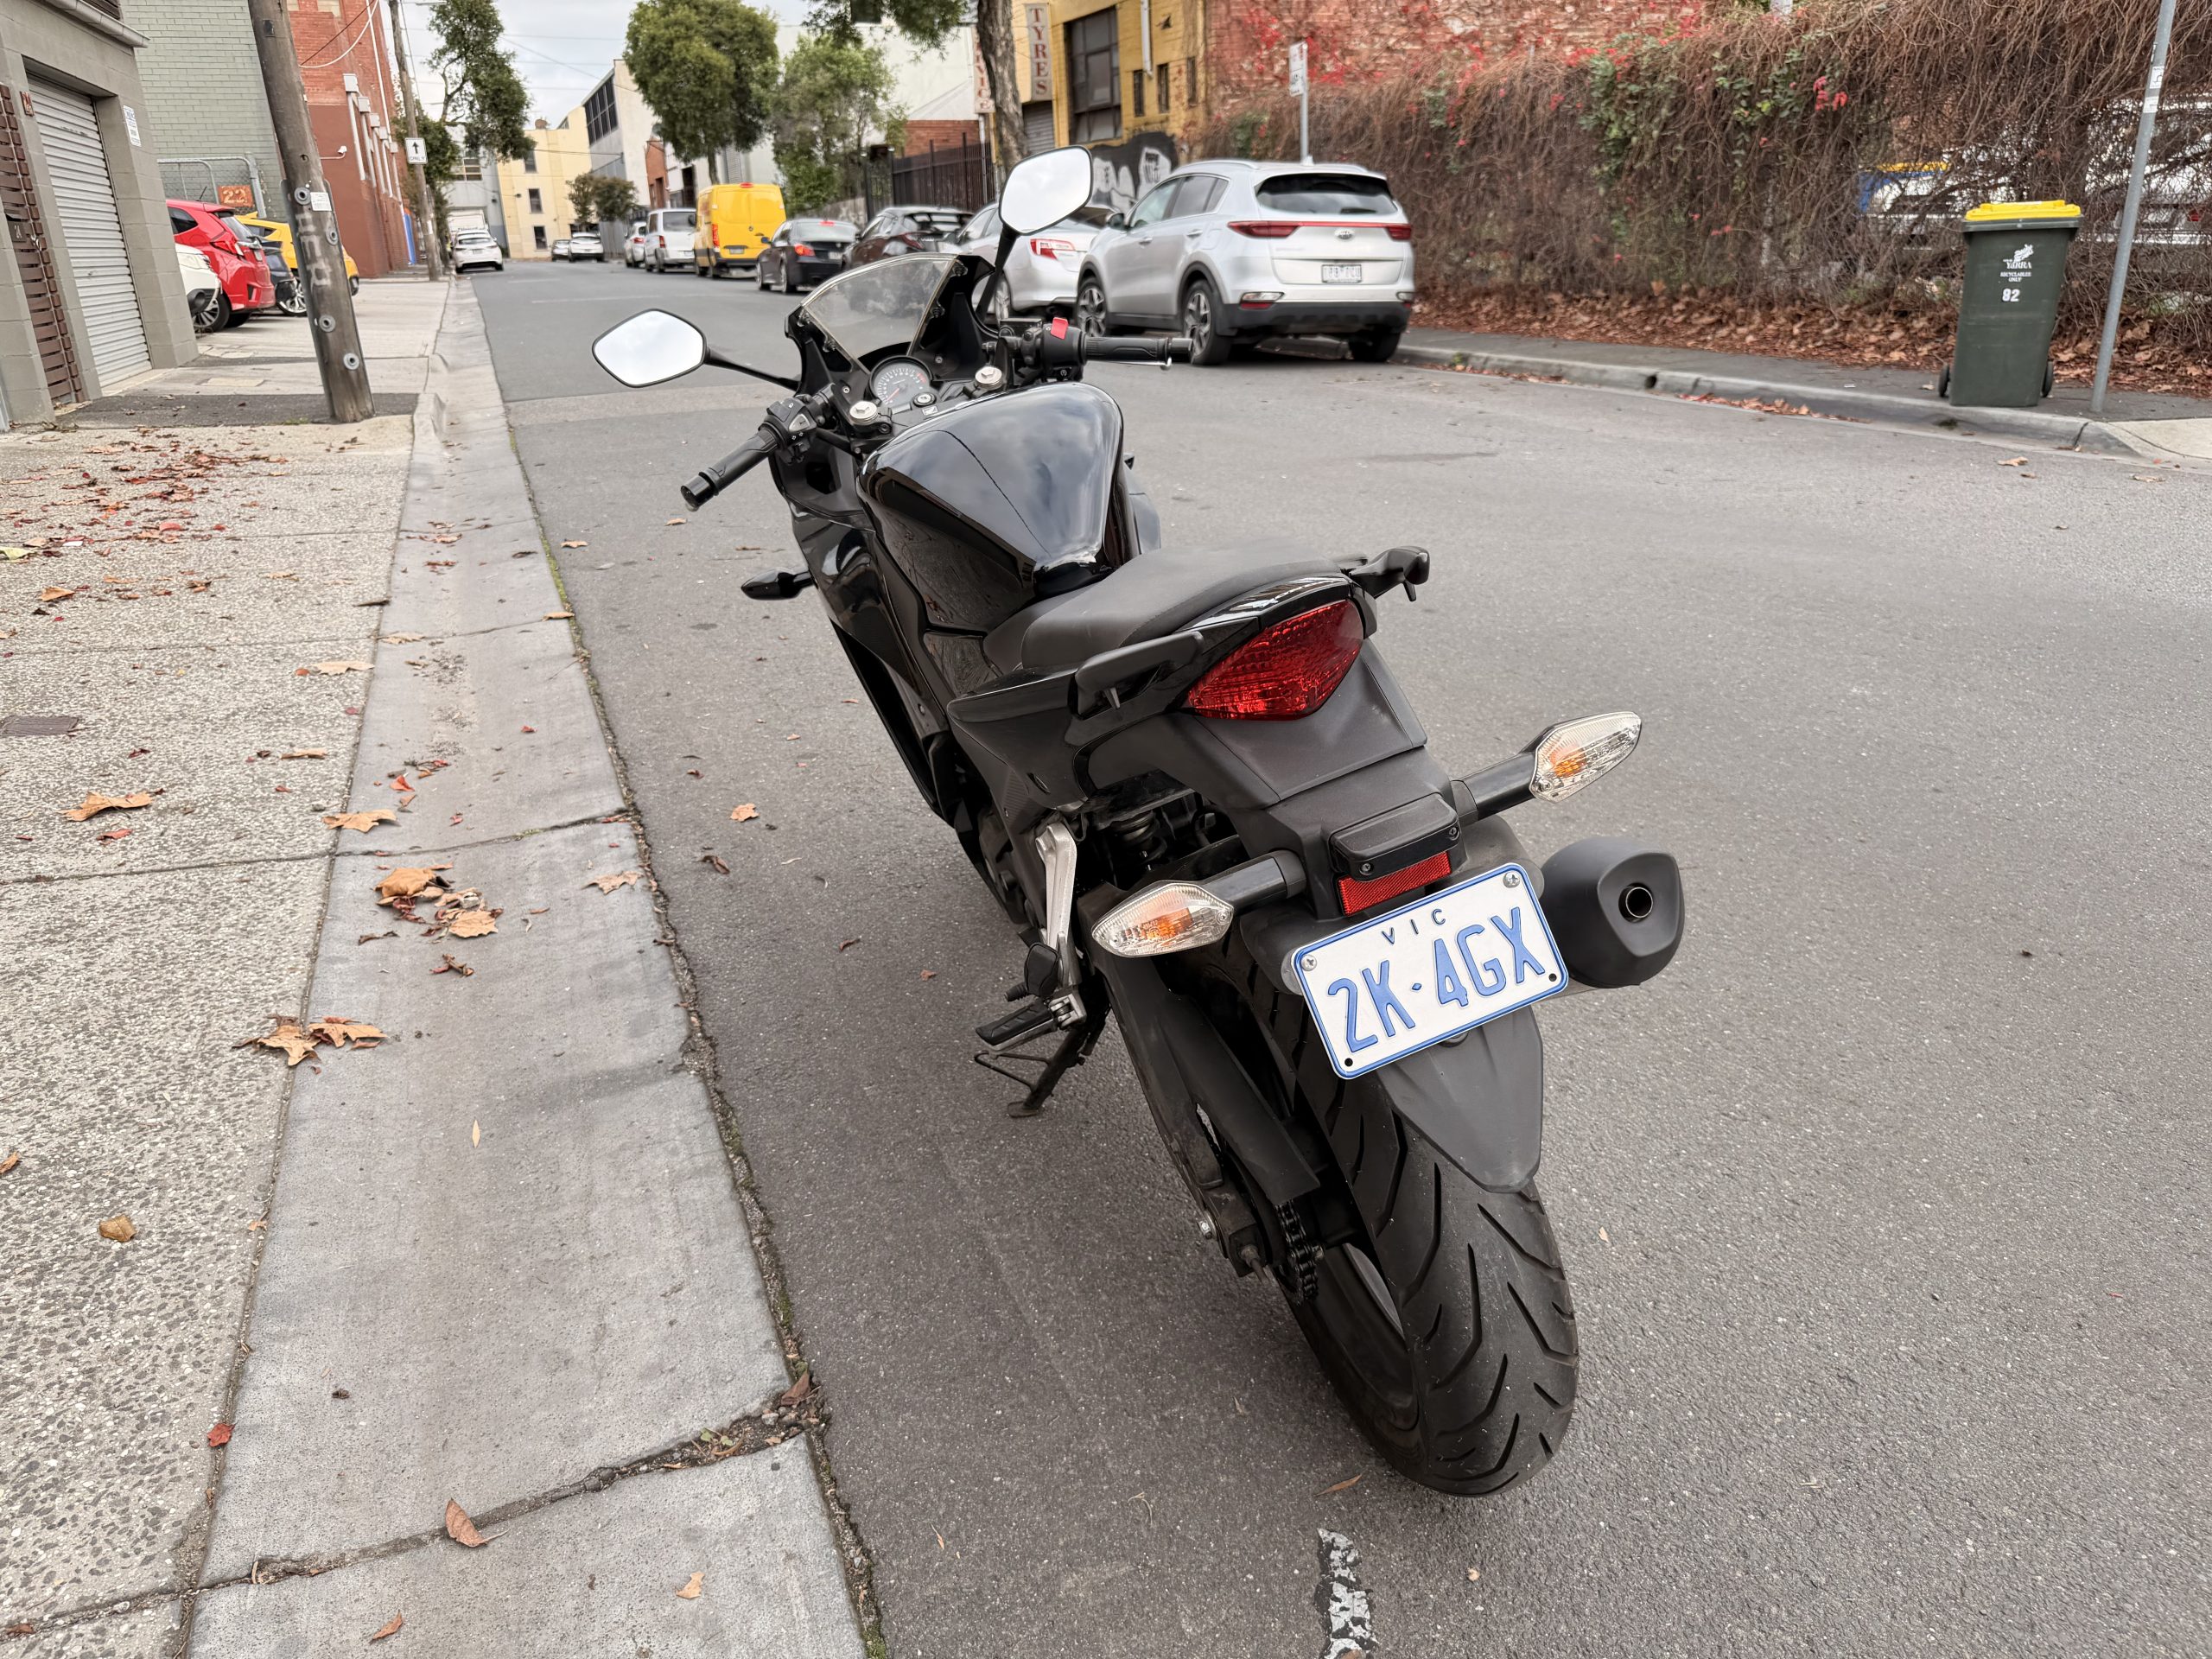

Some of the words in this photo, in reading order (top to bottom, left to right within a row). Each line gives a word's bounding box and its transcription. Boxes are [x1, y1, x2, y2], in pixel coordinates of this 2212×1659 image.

[1029, 8, 1049, 95] TYRES
[2002, 288, 2020, 302] 82
[1380, 908, 1446, 945] VIC
